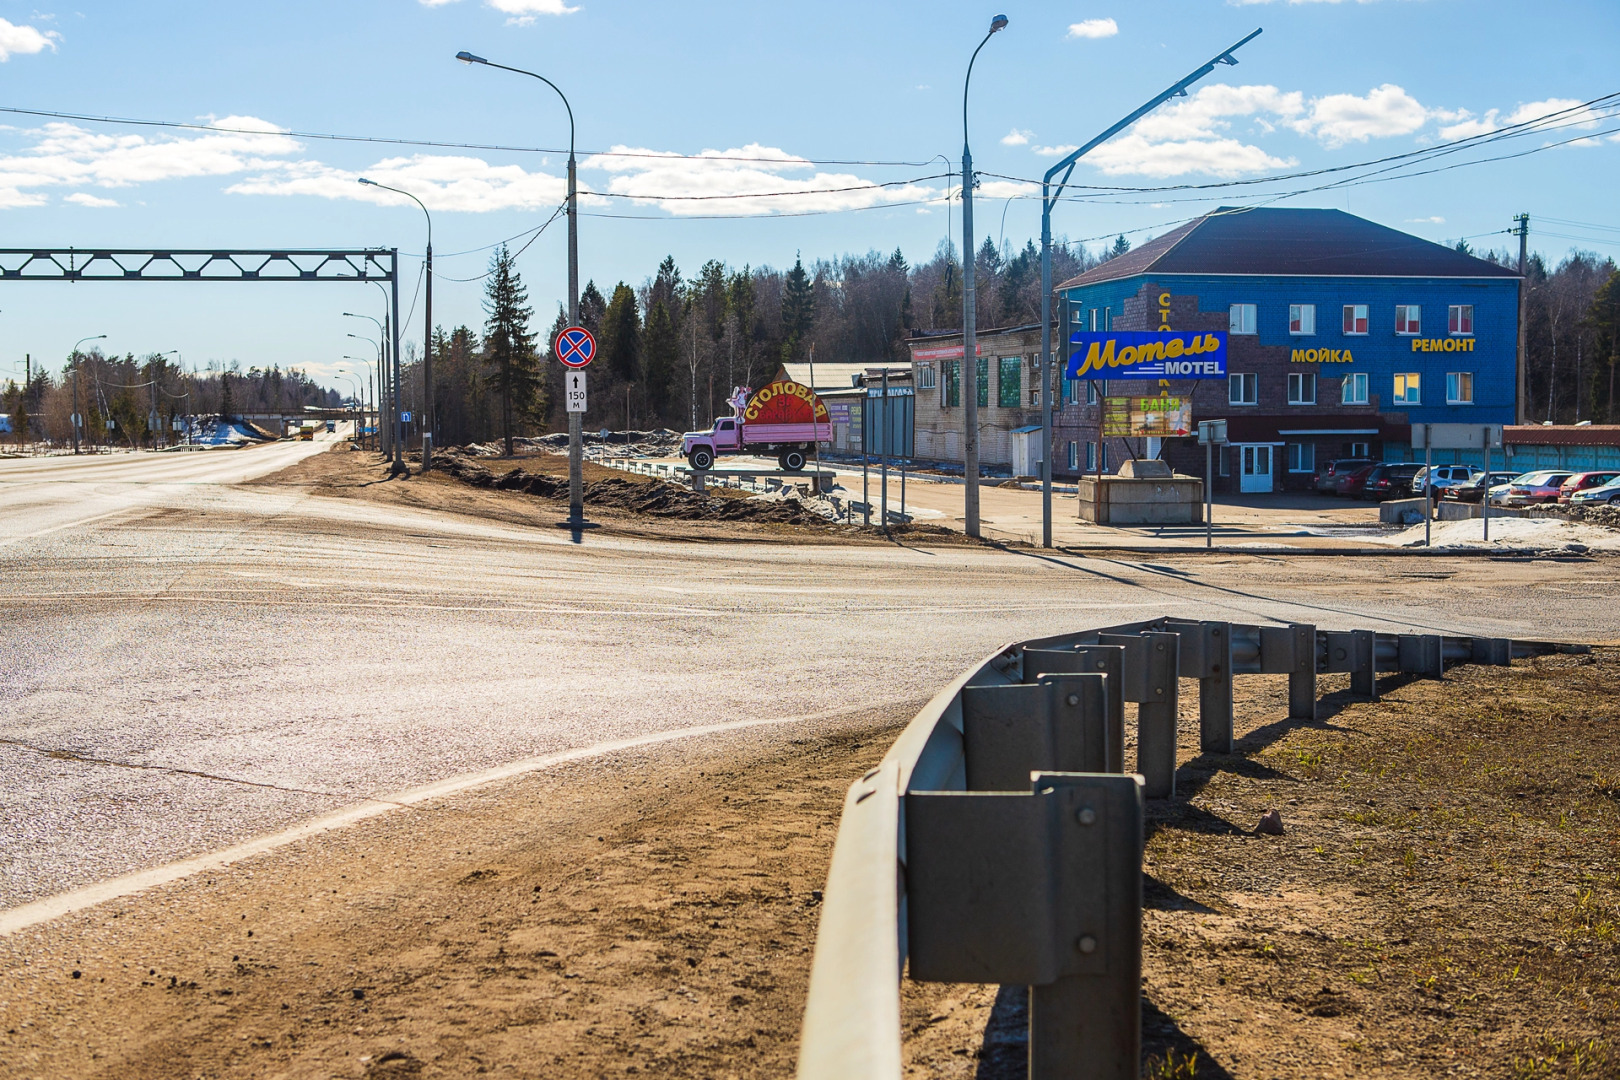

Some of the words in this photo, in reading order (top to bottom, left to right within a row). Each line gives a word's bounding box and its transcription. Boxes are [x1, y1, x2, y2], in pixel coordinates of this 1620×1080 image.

[1411, 338, 1476, 352] РЕМОНТ
[1076, 333, 1220, 377] Мотель
[1291, 347, 1354, 363] МОЙКА
[1165, 361, 1224, 375] MOTEL
[568, 391, 585, 400] 150
[745, 381, 827, 420] СТОЛОВАЯ
[1140, 398, 1180, 412] БАНЯ
